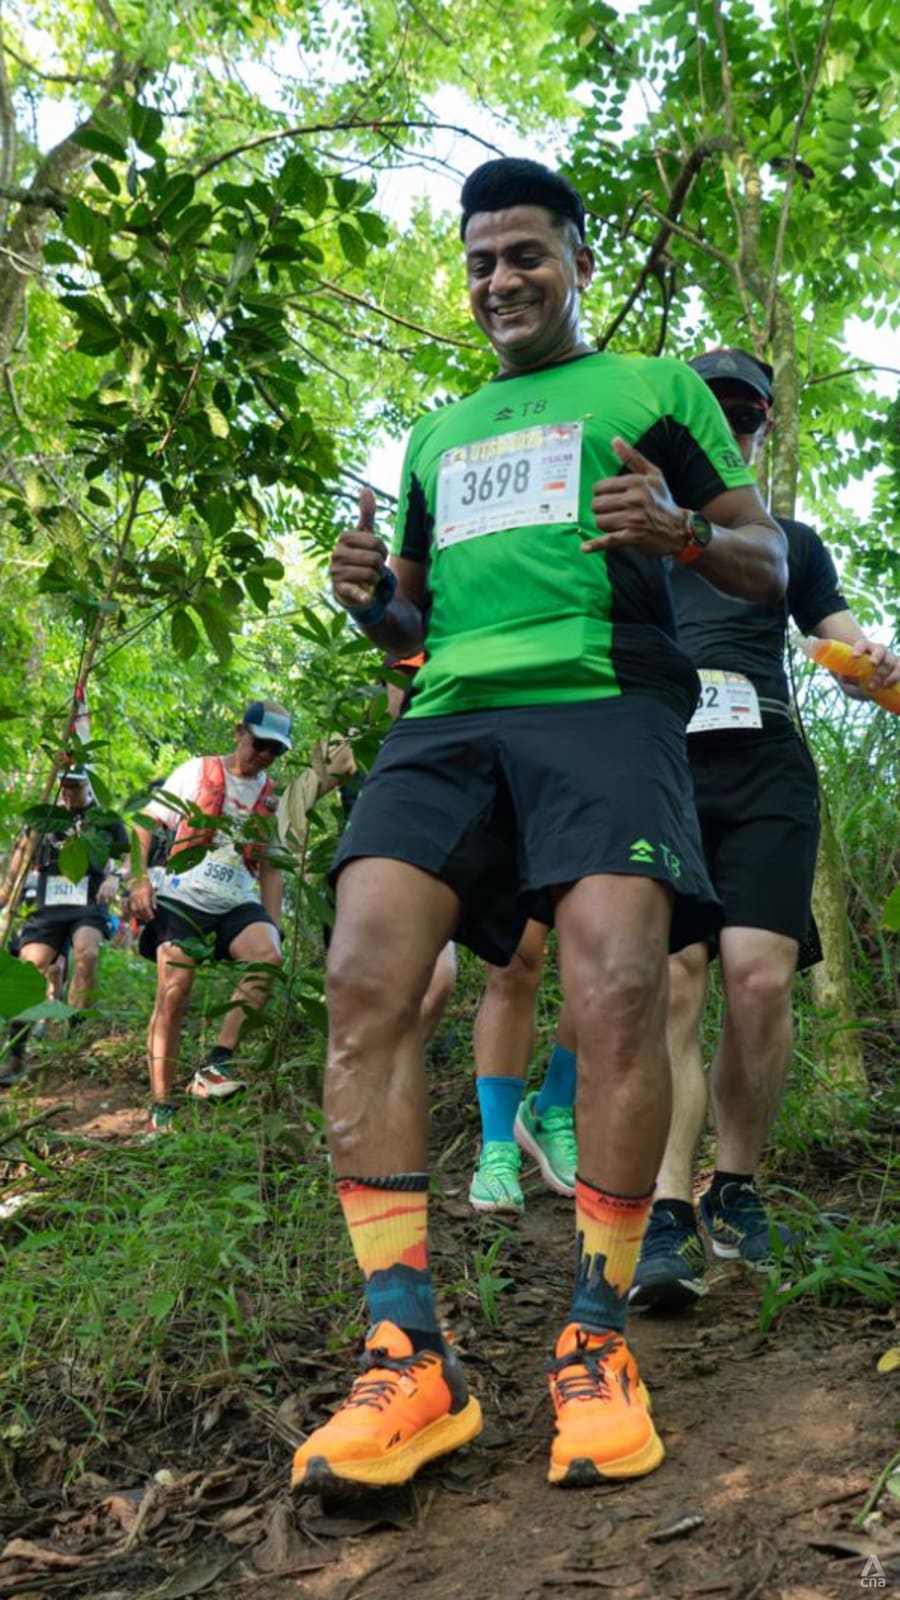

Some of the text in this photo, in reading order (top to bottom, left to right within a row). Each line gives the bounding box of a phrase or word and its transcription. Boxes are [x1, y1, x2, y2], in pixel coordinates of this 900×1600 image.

[520, 400, 547, 417] T8
[461, 459, 531, 506] 3698
[203, 862, 235, 883] 3589
